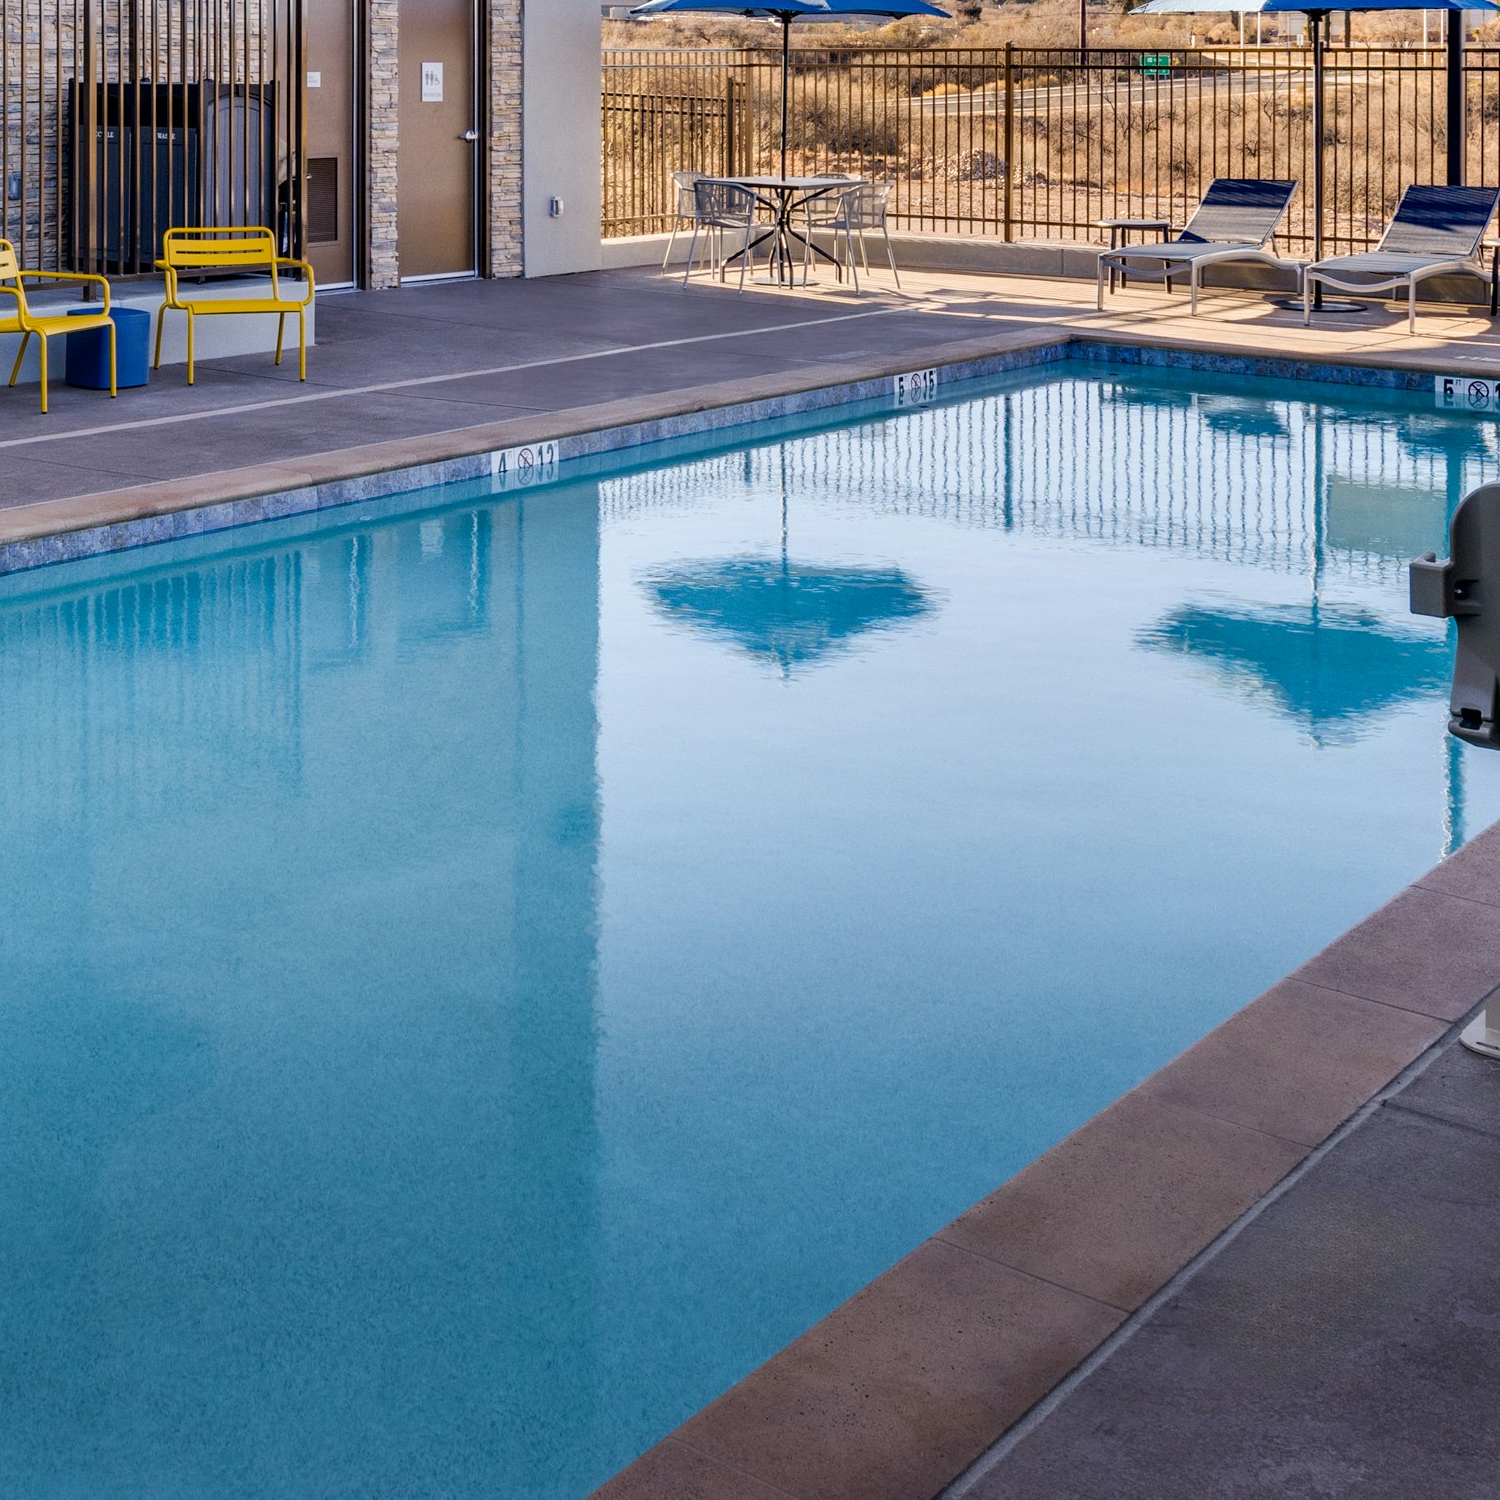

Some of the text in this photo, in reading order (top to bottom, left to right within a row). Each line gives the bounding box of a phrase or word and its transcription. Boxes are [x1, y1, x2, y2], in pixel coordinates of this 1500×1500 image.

[156, 132, 176, 140] WASE
[1443, 378, 1462, 395] 5 FT
[498, 451, 509, 473] 4
